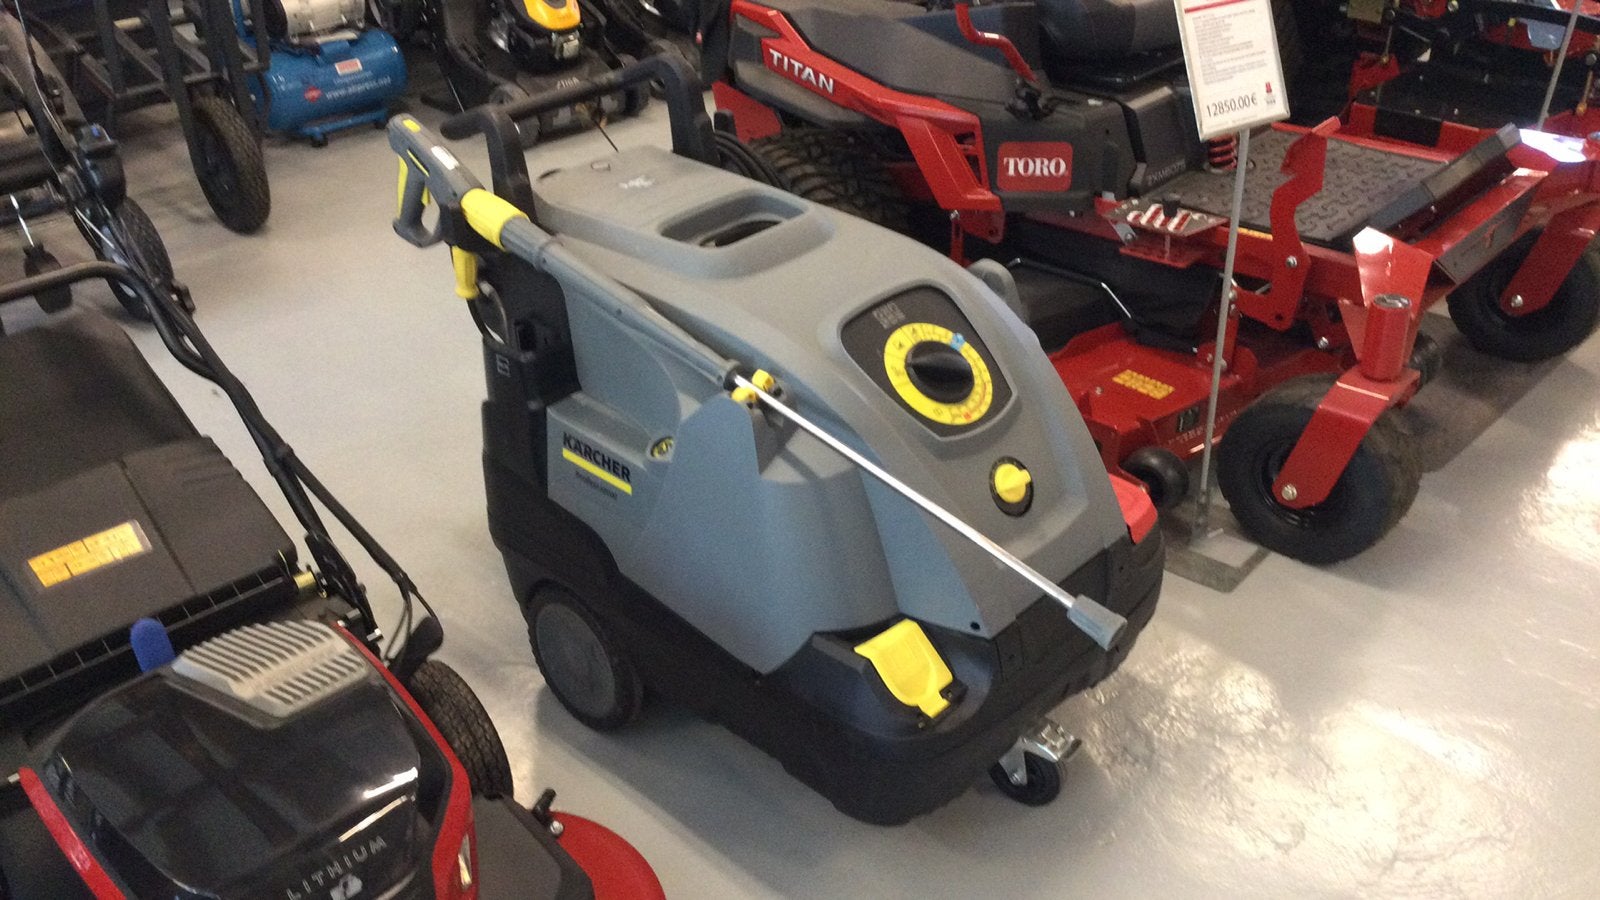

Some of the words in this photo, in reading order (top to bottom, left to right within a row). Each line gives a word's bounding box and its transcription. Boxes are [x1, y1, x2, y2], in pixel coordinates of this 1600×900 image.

[769, 48, 834, 94] TITAN
[1003, 156, 1067, 177] TORO
[286, 836, 387, 900] LITHIUM
